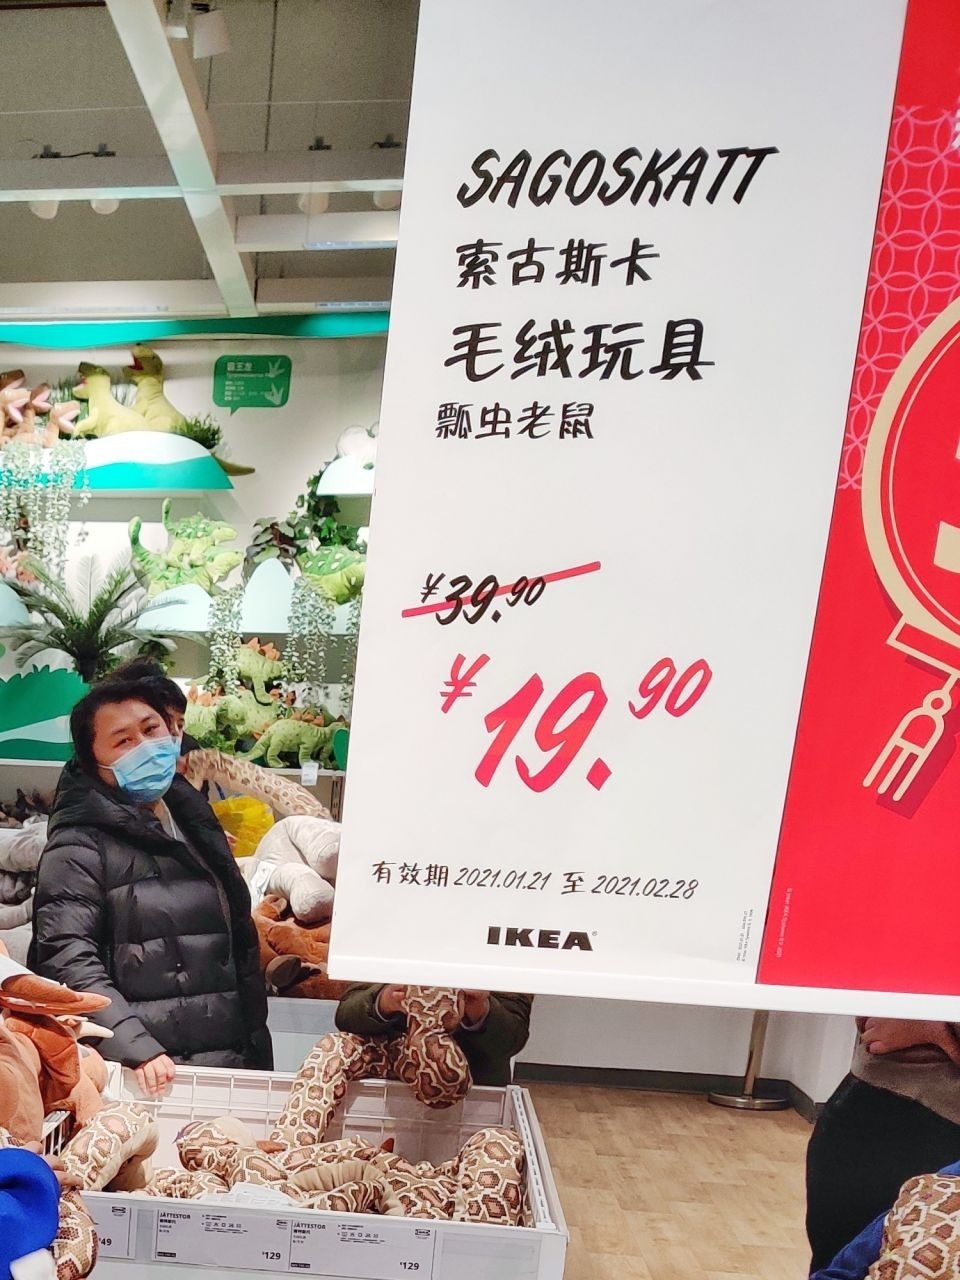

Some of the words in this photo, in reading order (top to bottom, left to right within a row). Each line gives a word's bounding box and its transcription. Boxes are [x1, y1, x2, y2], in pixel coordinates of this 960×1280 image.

[456, 145, 779, 208] SAGOSKATT
[456, 237, 661, 289] 索古斯卡
[443, 318, 715, 382] 毛绒玩具
[435, 401, 595, 440] 瓢虫老鼠
[372, 860, 449, 888] 有效期
[453, 866, 551, 892] 2021.01.21
[561, 871, 585, 895] 至
[591, 875, 700, 900] 2021.02.28
[486, 925, 595, 952] IKEA
